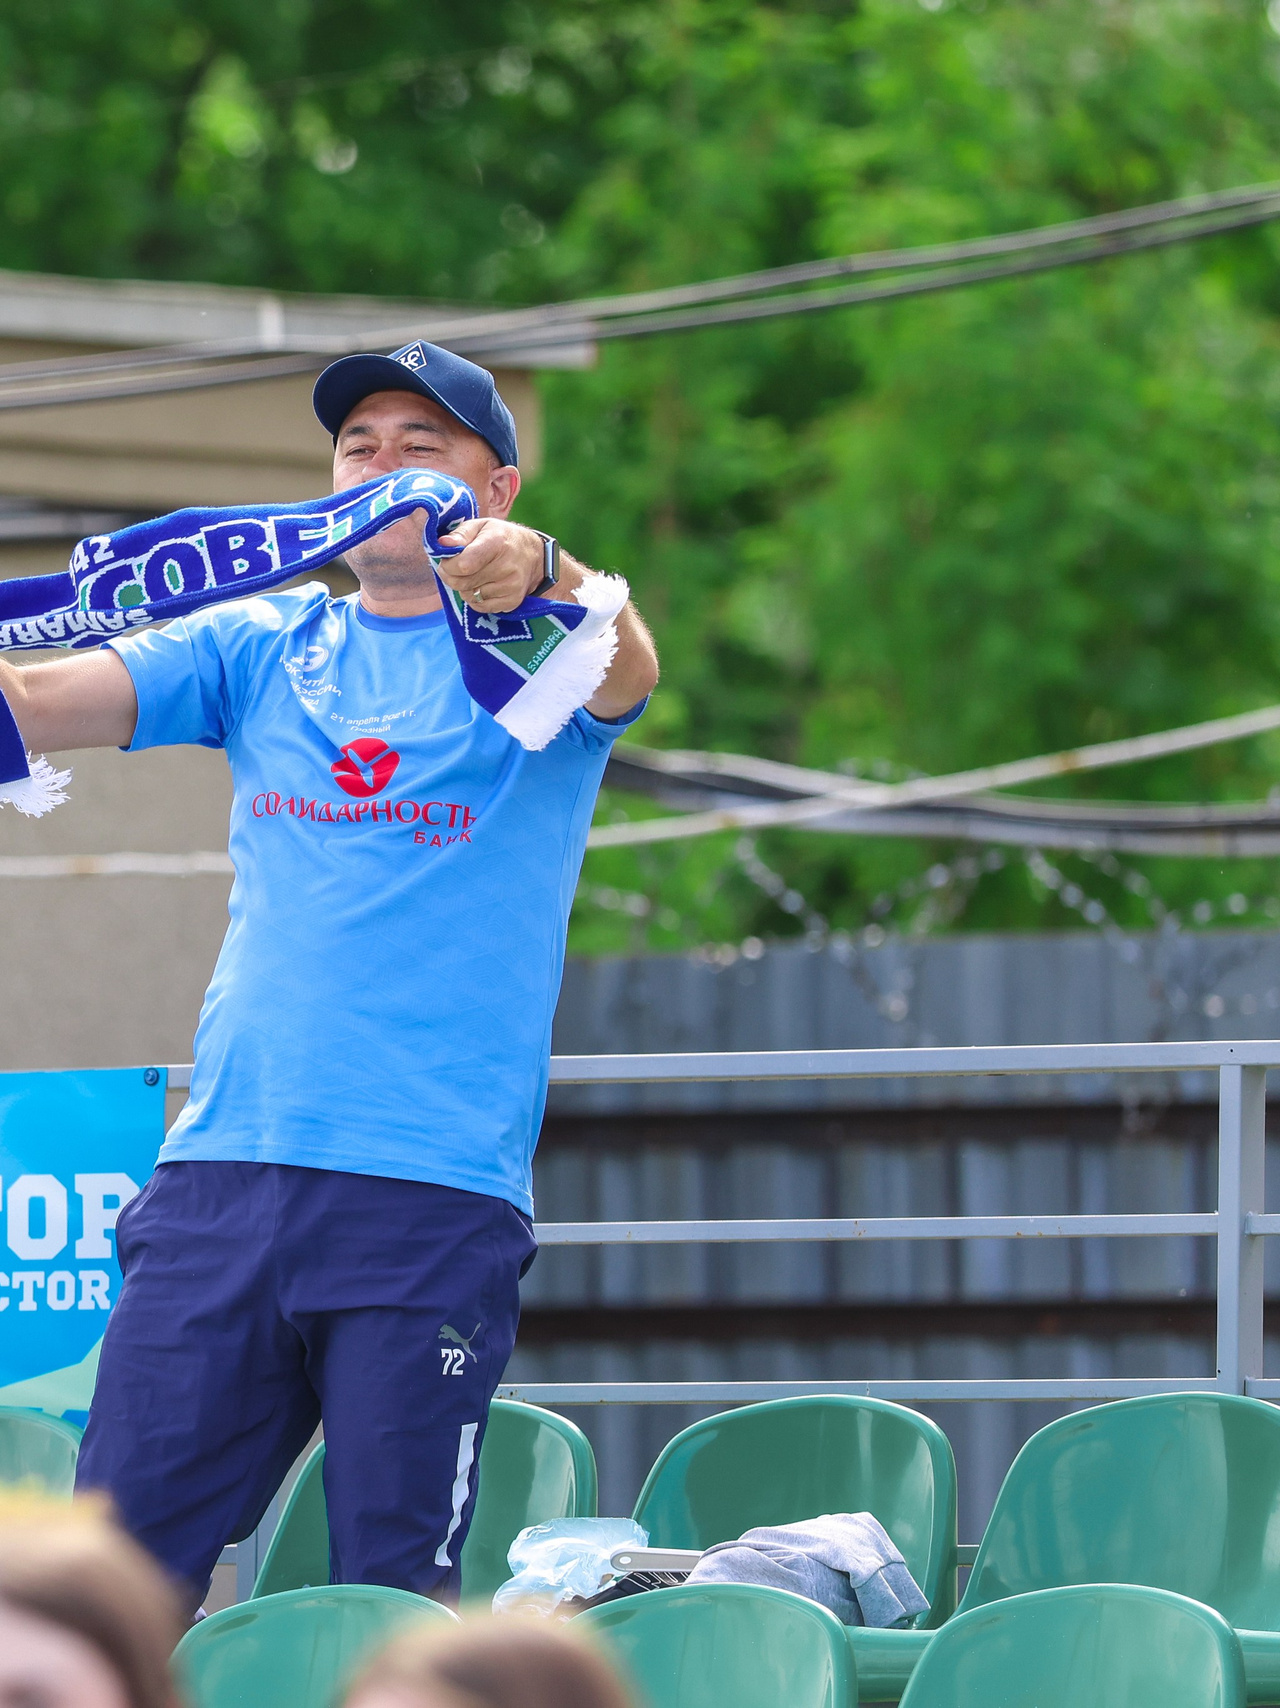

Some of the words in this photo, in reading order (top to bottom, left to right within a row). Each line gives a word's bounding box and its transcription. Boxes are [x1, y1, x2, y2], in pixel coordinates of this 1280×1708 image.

[526, 629, 564, 673] SAMARA
[330, 712, 344, 724] 21
[346, 716, 380, 727] апреля
[252, 791, 478, 829] СОЛИДАРНОСТЬ
[413, 829, 473, 848] БАНК
[440, 1348, 466, 1376] 72
